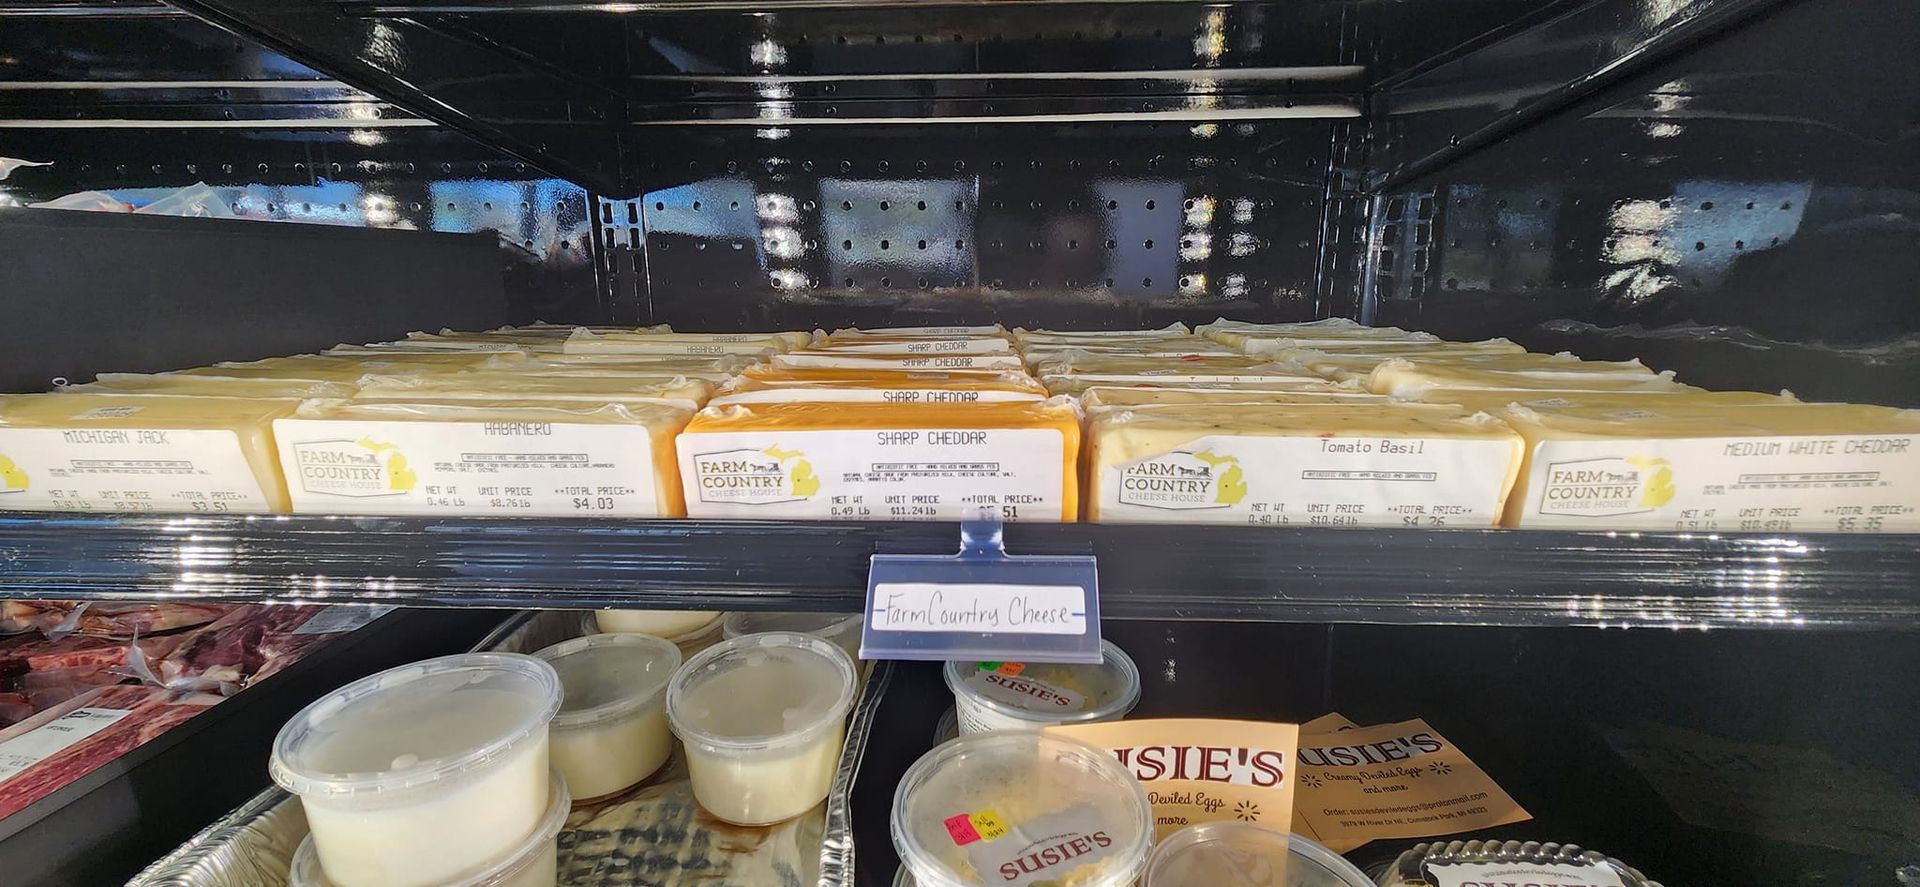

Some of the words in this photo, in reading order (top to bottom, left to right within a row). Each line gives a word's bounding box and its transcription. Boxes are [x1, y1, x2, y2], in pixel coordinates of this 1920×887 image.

[907, 343, 931, 352] SHARP
[935, 341, 968, 351] CHEDDAR
[934, 357, 973, 367] CHEDDAR
[883, 391, 919, 403] SHARP
[926, 391, 979, 403] CHEDDAR
[484, 422, 552, 436] HABANERO
[63, 431, 129, 444] MICHIGAN
[136, 431, 170, 445] JACK
[878, 431, 919, 446] SHARP
[927, 431, 987, 445] CHEDDAR
[1320, 439, 1372, 454] Tomato
[1380, 439, 1425, 455] Basil
[1723, 441, 1781, 457] MEDIUM
[1788, 440, 1838, 456] WHITE
[1844, 439, 1911, 455] CHEDDAR
[301, 451, 345, 464] FARM
[303, 466, 381, 481] COUNTRY
[701, 461, 747, 474] FARM
[703, 476, 784, 489] COUNTRY
[1552, 470, 1604, 484] FARM
[310, 480, 348, 488] CHEESE
[350, 481, 381, 489] HOUSE
[426, 486, 444, 495] NET
[1124, 478, 1211, 493] COUNTRY
[477, 486, 500, 496] UNIT
[504, 487, 533, 496] PRICE
[708, 489, 748, 498] CHEESE
[751, 489, 783, 497] HOUSE
[1549, 486, 1639, 500] COUNTRY
[573, 497, 614, 510] $4.03
[831, 495, 850, 504] NET
[853, 495, 864, 504] WT
[885, 495, 908, 504] UNIT
[911, 495, 940, 504] PRICE
[1128, 492, 1168, 501] CHEESE
[1171, 493, 1206, 503] HOUSE
[192, 500, 228, 512] $351
[831, 506, 853, 516] 0.49
[1251, 503, 1268, 512] NET
[1273, 503, 1285, 513] WT
[1307, 503, 1331, 513] UNIT
[1335, 504, 1365, 514] PRICE
[1550, 500, 1591, 510] CHEESE
[1594, 500, 1631, 509] HOUSE
[1680, 509, 1699, 519] NET
[1738, 508, 1765, 517] UNIT
[1769, 507, 1801, 517] PRICE
[1402, 516, 1446, 527] $426
[1675, 520, 1700, 530] 051
[1836, 517, 1885, 531] $5.35
[1007, 596, 1070, 626] Cheese
[985, 674, 1071, 707] SUSIE'S
[1298, 732, 1444, 767] USIE'S
[1112, 745, 1284, 788] SIE'S
[1323, 771, 1363, 784] Creamy
[1360, 768, 1398, 781] Deviled
[1396, 766, 1424, 779] Eggs
[1363, 785, 1382, 794] and
[1147, 791, 1192, 806] Deviled
[1195, 793, 1226, 813] Eggs
[1323, 806, 1349, 817] Order:
[999, 831, 1112, 881] SUSIE'S
